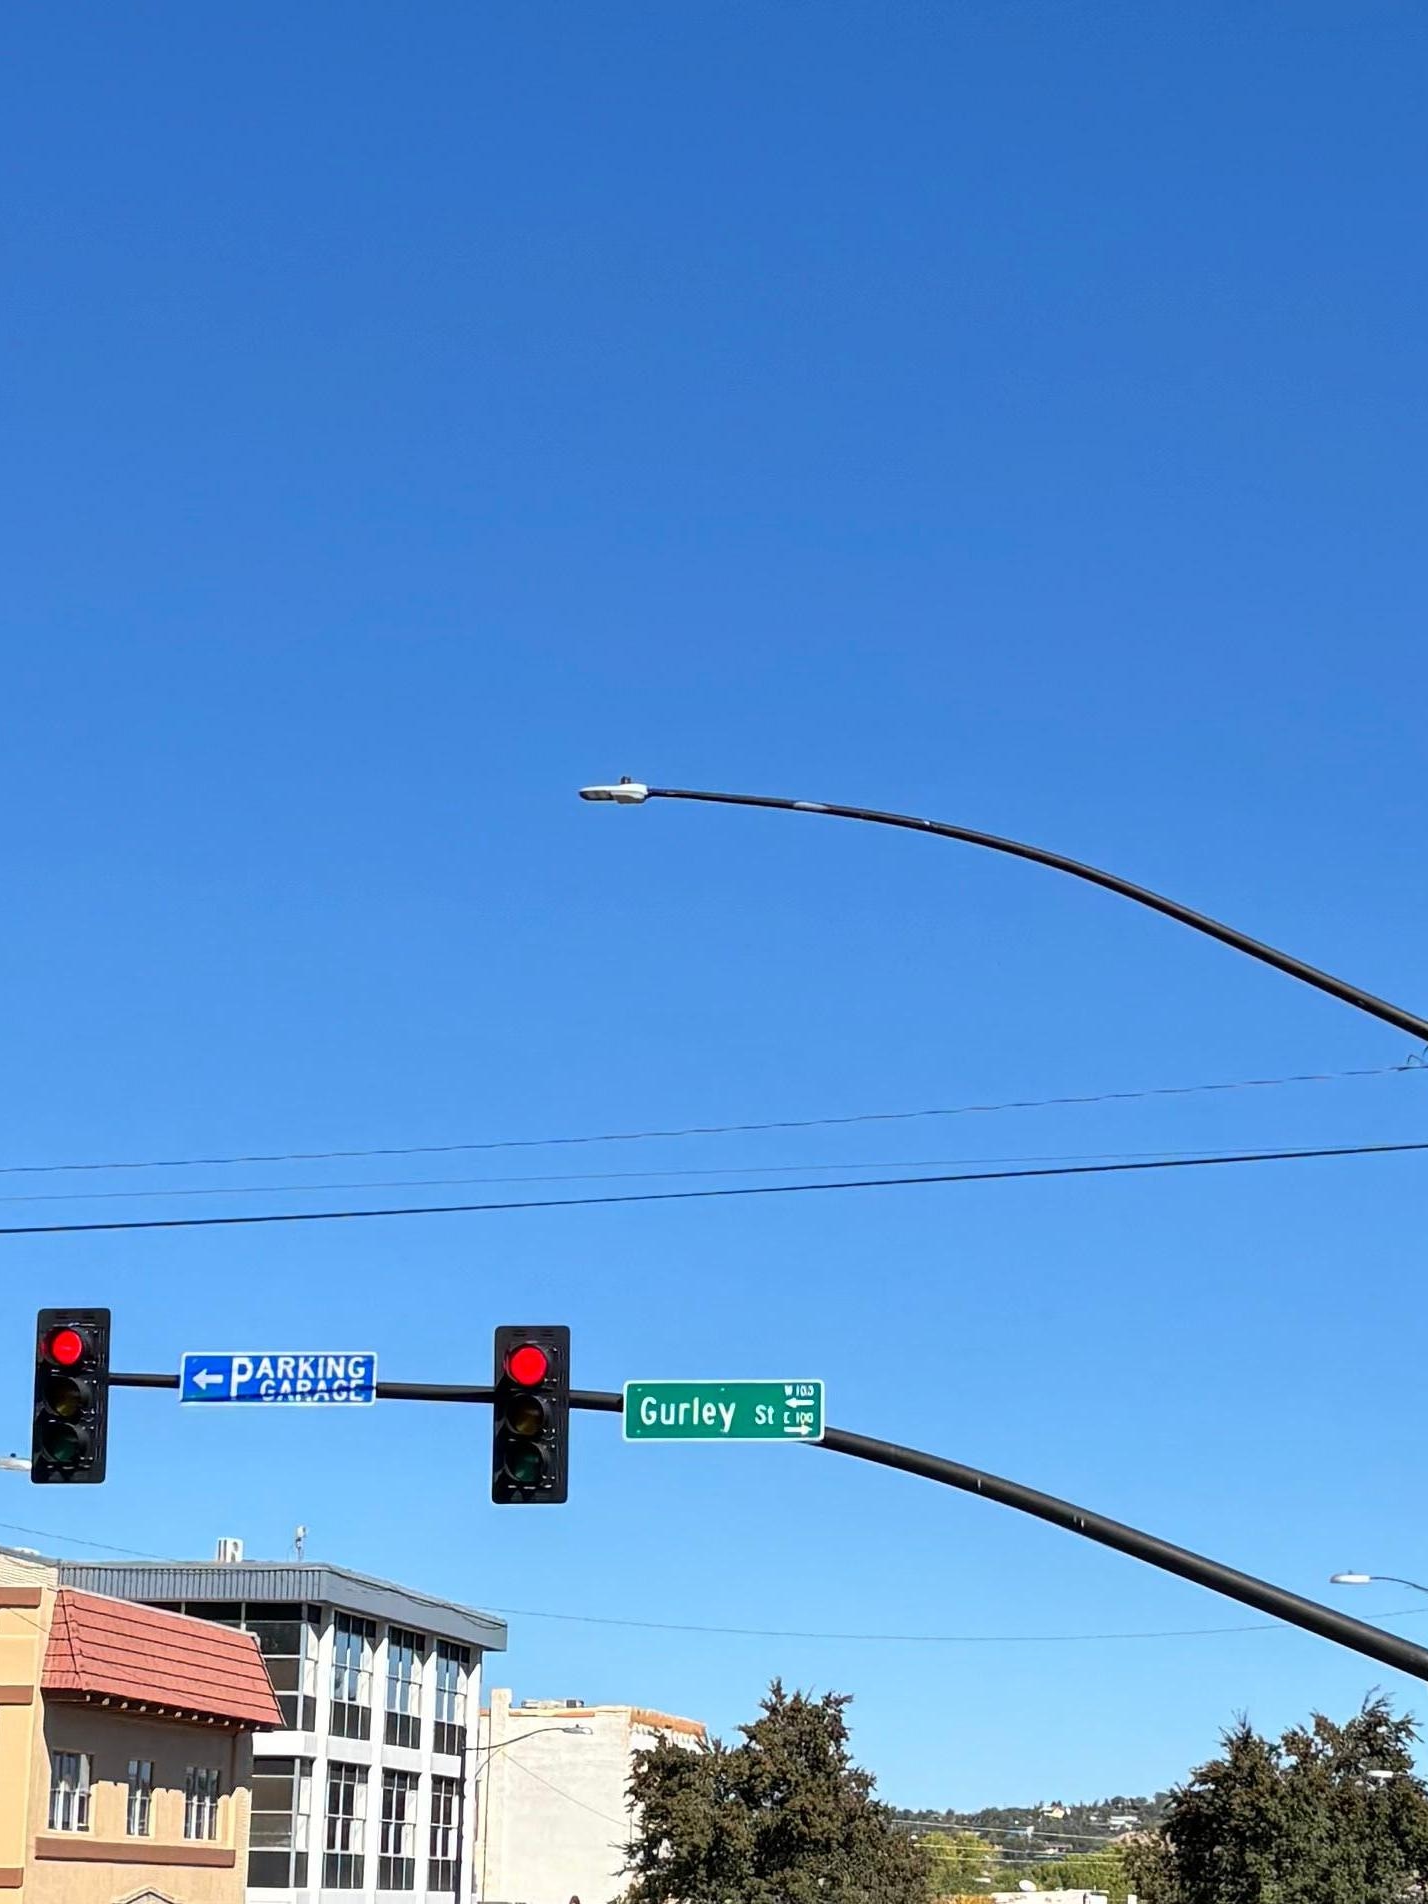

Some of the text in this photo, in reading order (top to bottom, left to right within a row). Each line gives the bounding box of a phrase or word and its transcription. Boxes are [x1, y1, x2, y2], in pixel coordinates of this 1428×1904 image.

[230, 1356, 365, 1400] PARKING
[260, 1379, 364, 1401] GARAGE
[640, 1396, 775, 1433] Gurley St
